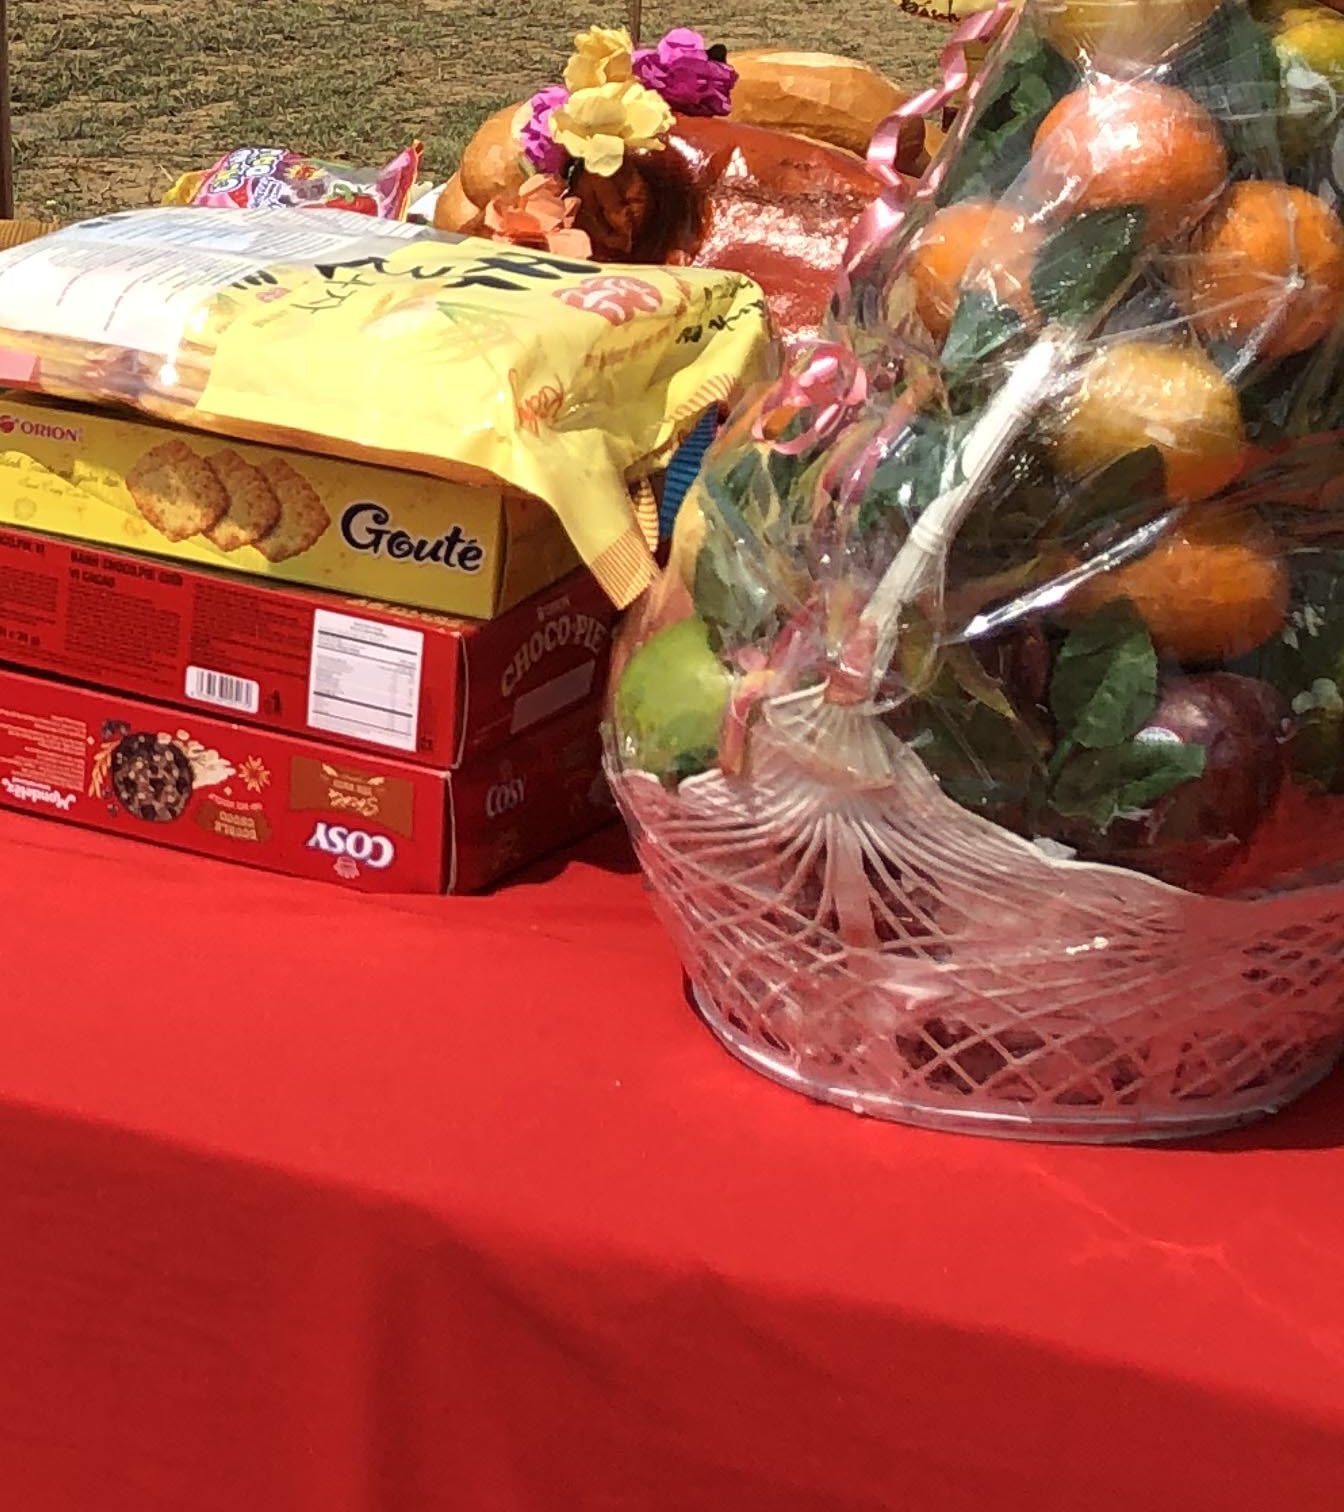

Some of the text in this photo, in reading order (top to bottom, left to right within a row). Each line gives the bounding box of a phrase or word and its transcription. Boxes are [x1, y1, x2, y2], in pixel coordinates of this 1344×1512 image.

[20, 420, 78, 442] ORION
[342, 502, 484, 572] Gouté
[307, 822, 394, 868] COSY
